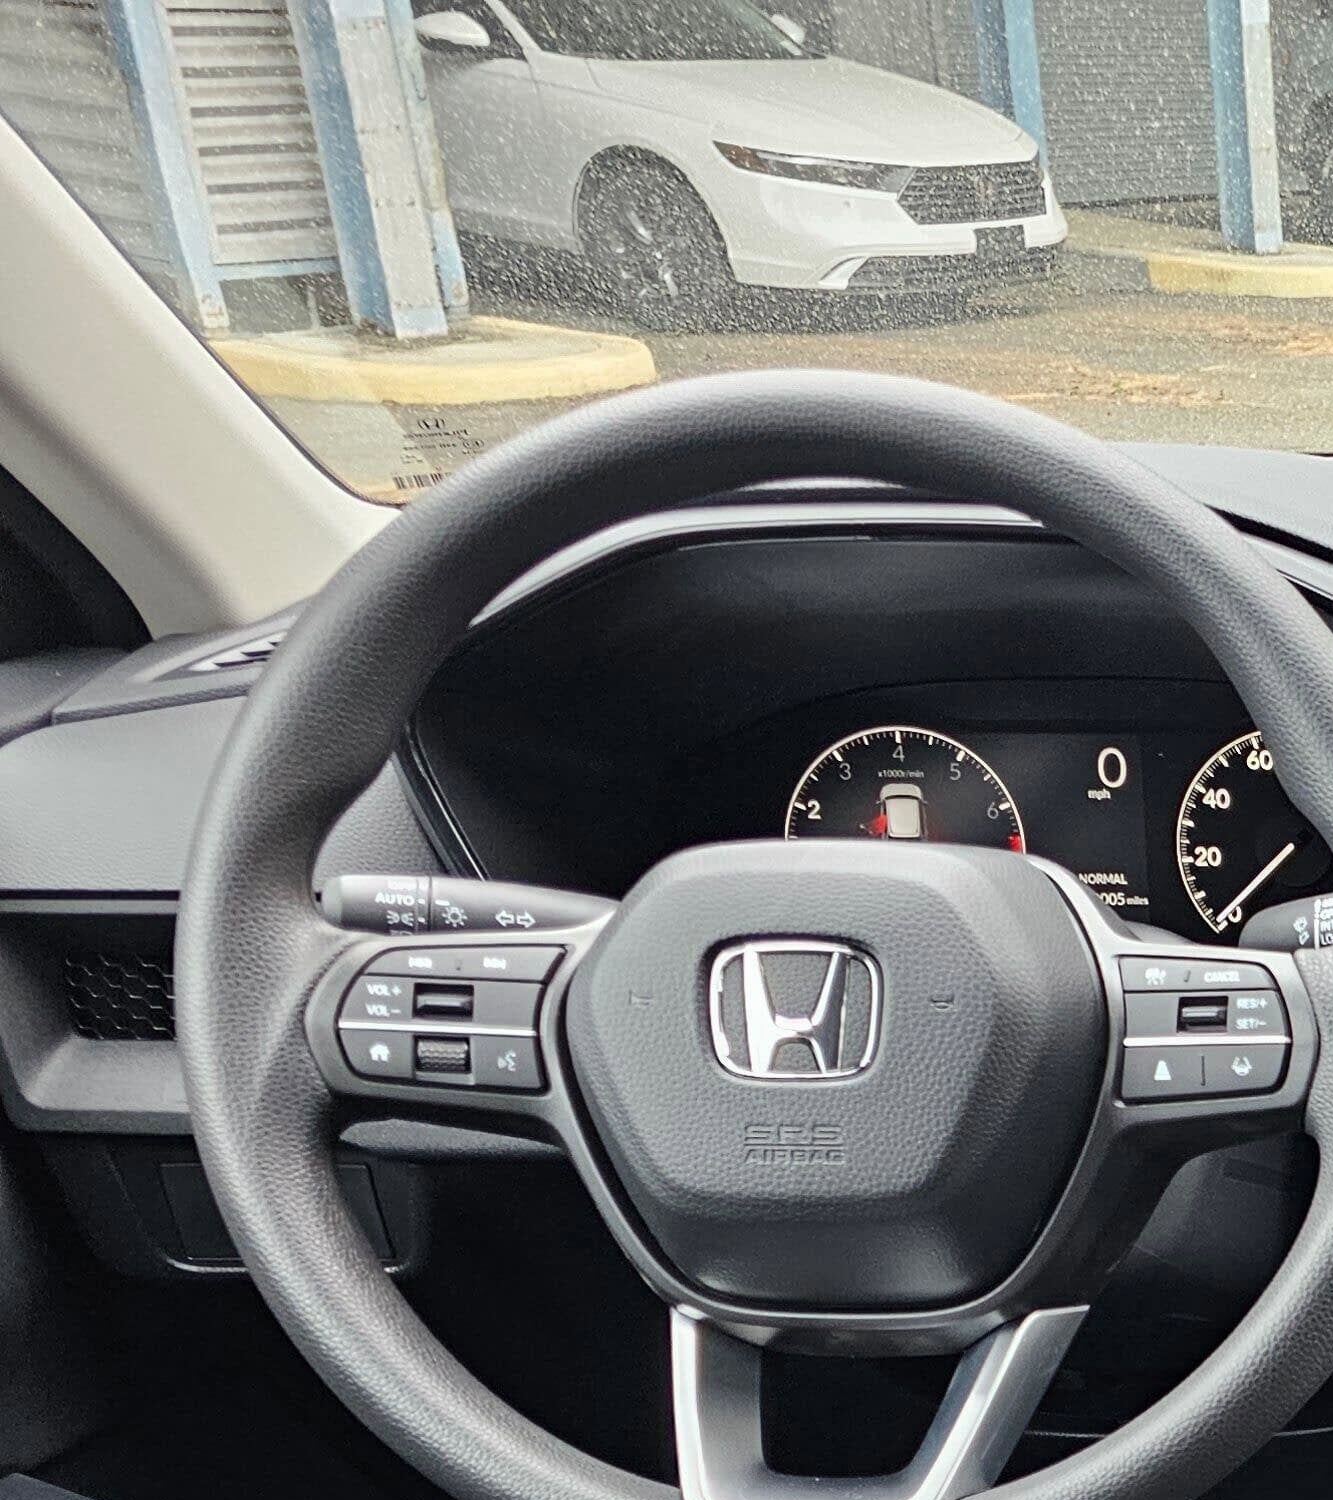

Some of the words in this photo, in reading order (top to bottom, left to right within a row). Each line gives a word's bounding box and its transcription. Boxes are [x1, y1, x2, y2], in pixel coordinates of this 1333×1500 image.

[892, 745, 905, 763] 4
[1246, 750, 1274, 771] 60
[839, 763, 852, 781] 3
[950, 763, 962, 781] 5
[1097, 747, 1128, 788] 0
[1087, 789, 1111, 800] mph
[1202, 788, 1231, 809] 40
[807, 799, 821, 820] 2
[987, 802, 1000, 820] 6
[1194, 846, 1222, 867] 20
[1078, 873, 1128, 886] NORMAL
[374, 891, 416, 907] AUTO
[366, 983, 391, 997] VOL
[365, 1003, 391, 1017] VOL
